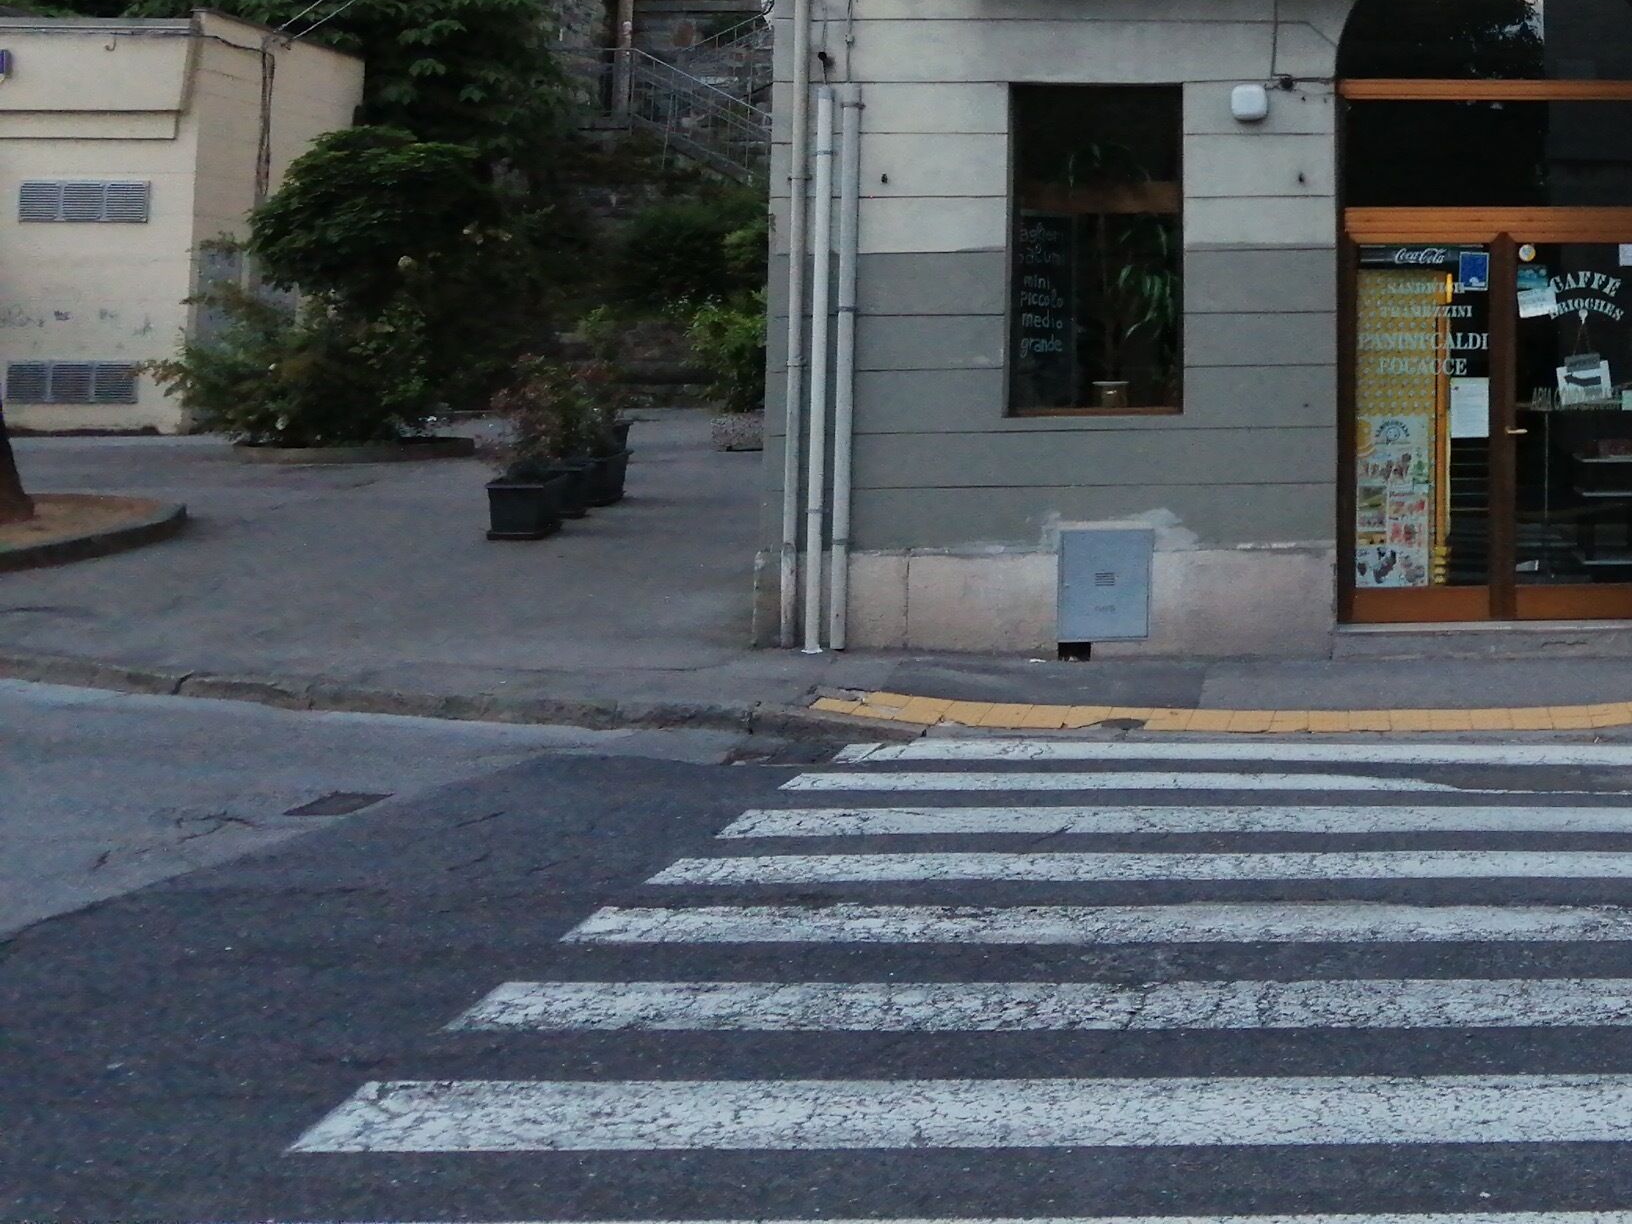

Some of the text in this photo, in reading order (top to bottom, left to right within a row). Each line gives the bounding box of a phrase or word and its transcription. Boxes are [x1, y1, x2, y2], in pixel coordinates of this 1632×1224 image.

[1021, 309, 1064, 328] medio
[1020, 333, 1063, 358] grande
[1431, 332, 1489, 350] CALDI
